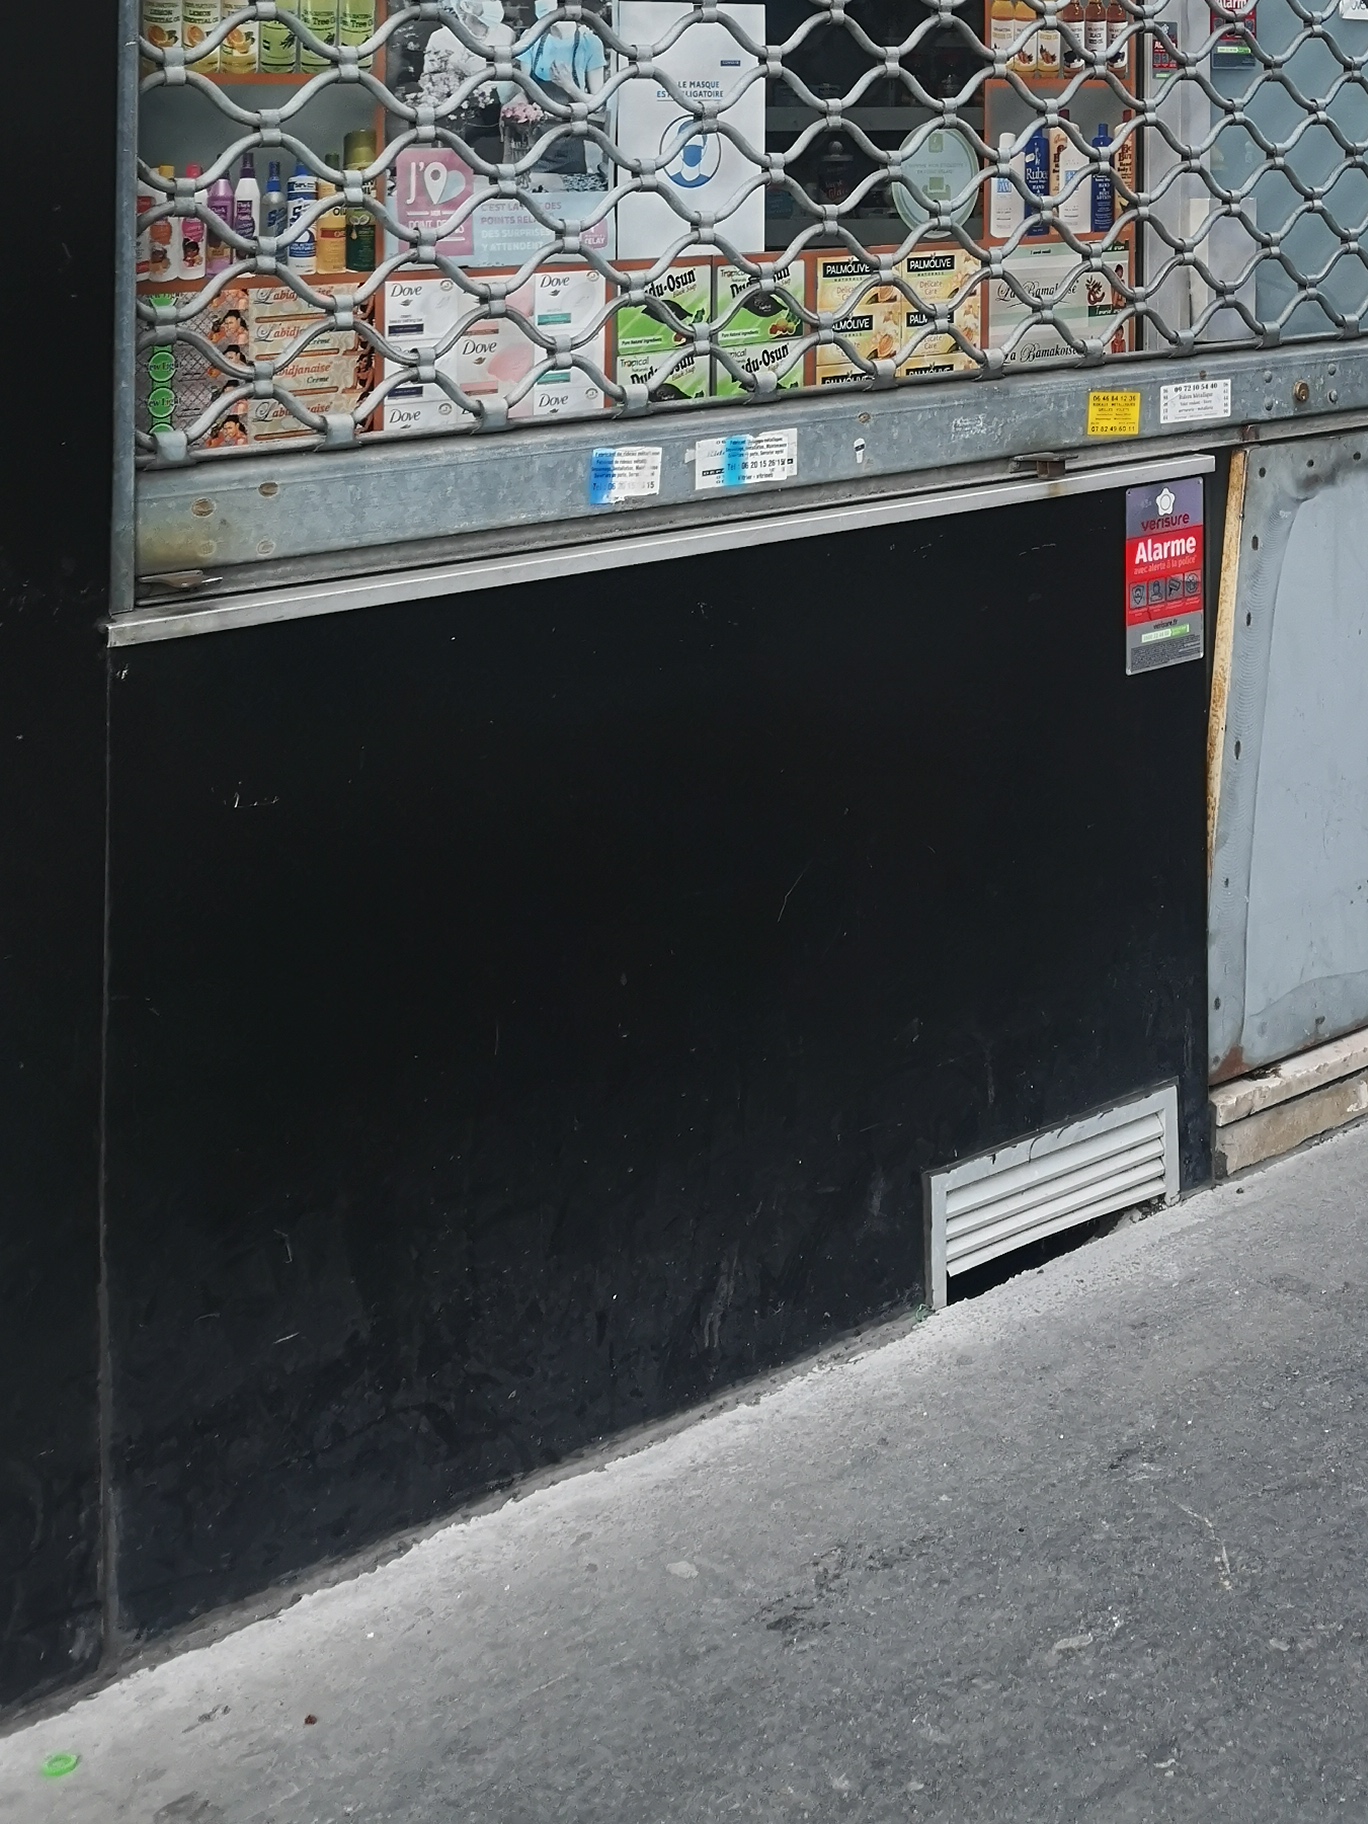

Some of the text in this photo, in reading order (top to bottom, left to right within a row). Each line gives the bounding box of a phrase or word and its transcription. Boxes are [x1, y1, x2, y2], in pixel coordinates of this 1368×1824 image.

[689, 80, 720, 89] MASQUE
[681, 90, 724, 98] LIGATOIRE
[480, 202, 506, 211] C'EST
[480, 216, 515, 225] POINTS
[480, 227, 551, 238] DES SURPRISES
[825, 263, 871, 276] PALMOLIVE
[909, 257, 952, 270] PALMOLIVE
[539, 274, 571, 288] Dove
[644, 267, 696, 299] du-Osun
[919, 280, 943, 289] Delicate
[390, 283, 423, 298] Dove
[924, 287, 938, 295] Care
[832, 318, 870, 332] ALMOLIVE
[462, 339, 498, 356] Dove
[924, 341, 938, 350] Care
[619, 356, 650, 368] Tropical
[306, 375, 330, 384] Crème
[538, 393, 569, 408] Dove
[389, 408, 421, 424] Dove
[750, 460, 758, 469] 20
[759, 459, 767, 468] 15
[1141, 513, 1190, 532] verisure
[1134, 535, 1197, 565] Alarme
[1133, 566, 1148, 575] avec
[1148, 562, 1166, 572] alerte
[1171, 558, 1178, 568] la
